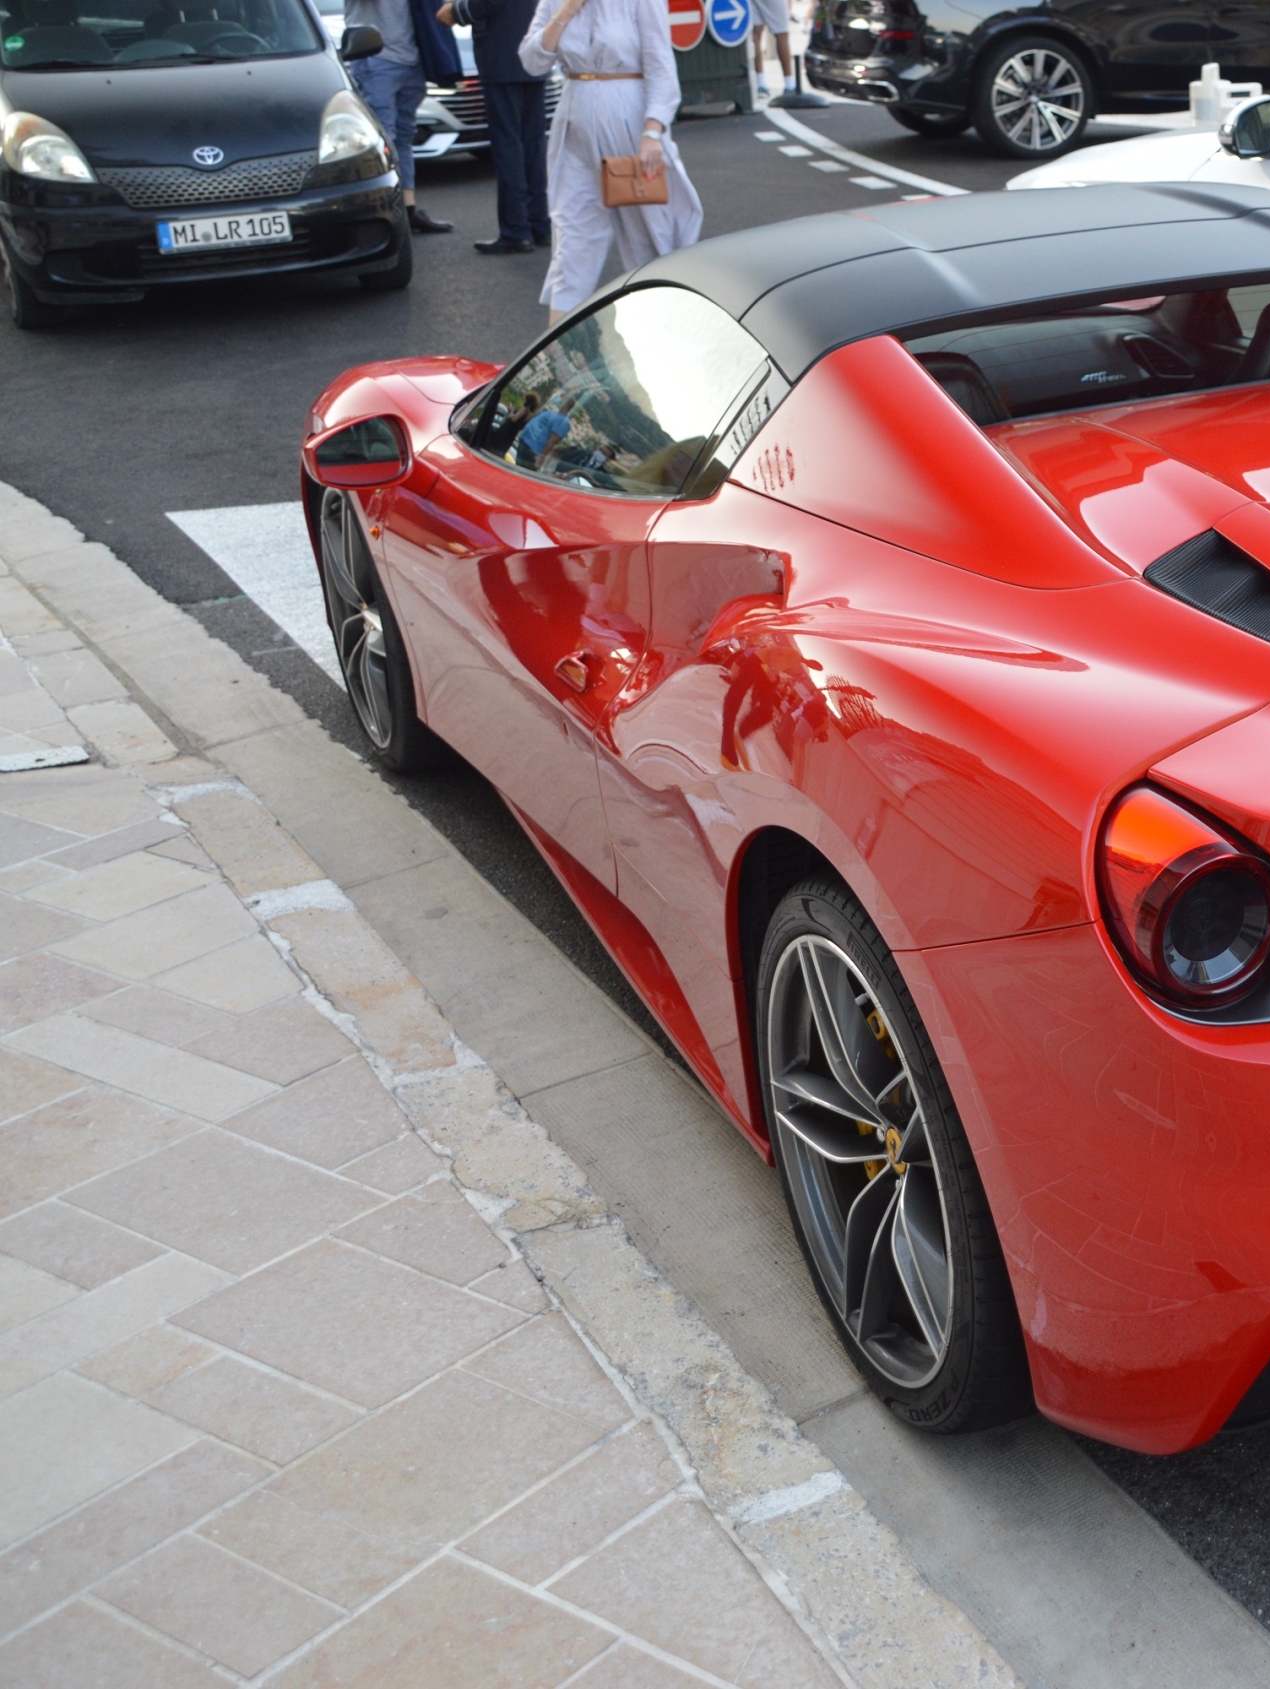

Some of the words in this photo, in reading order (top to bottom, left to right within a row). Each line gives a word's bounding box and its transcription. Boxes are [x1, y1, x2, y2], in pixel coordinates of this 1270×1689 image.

[172, 223, 200, 245] MI
[213, 220, 243, 241] LR
[246, 215, 285, 237] 105
[846, 930, 882, 991] PIRELLI
